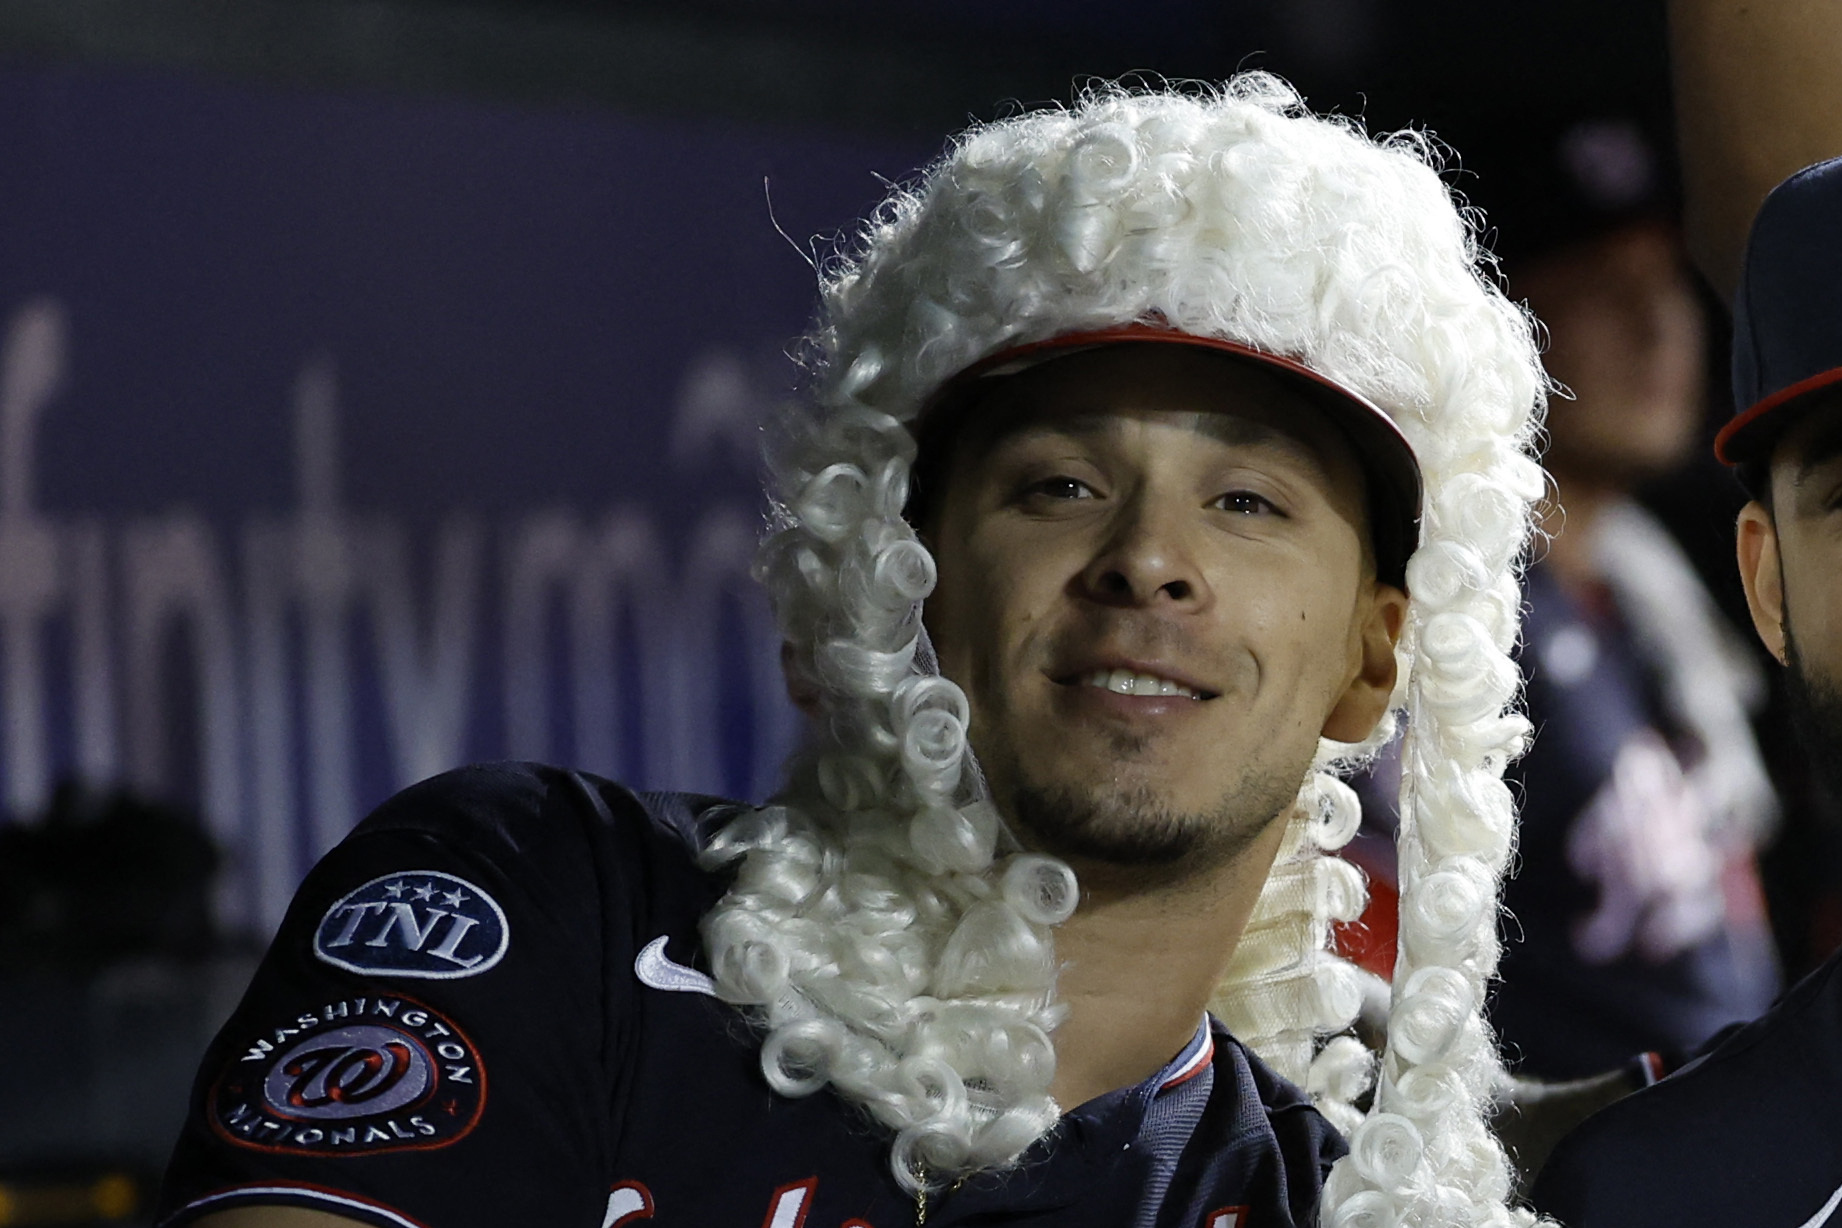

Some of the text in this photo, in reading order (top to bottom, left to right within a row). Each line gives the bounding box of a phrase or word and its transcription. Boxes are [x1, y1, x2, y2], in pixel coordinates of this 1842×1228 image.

[326, 901, 484, 969] TNL
[241, 997, 473, 1085] WASHINGTON
[226, 1103, 436, 1146] NATIONALS
